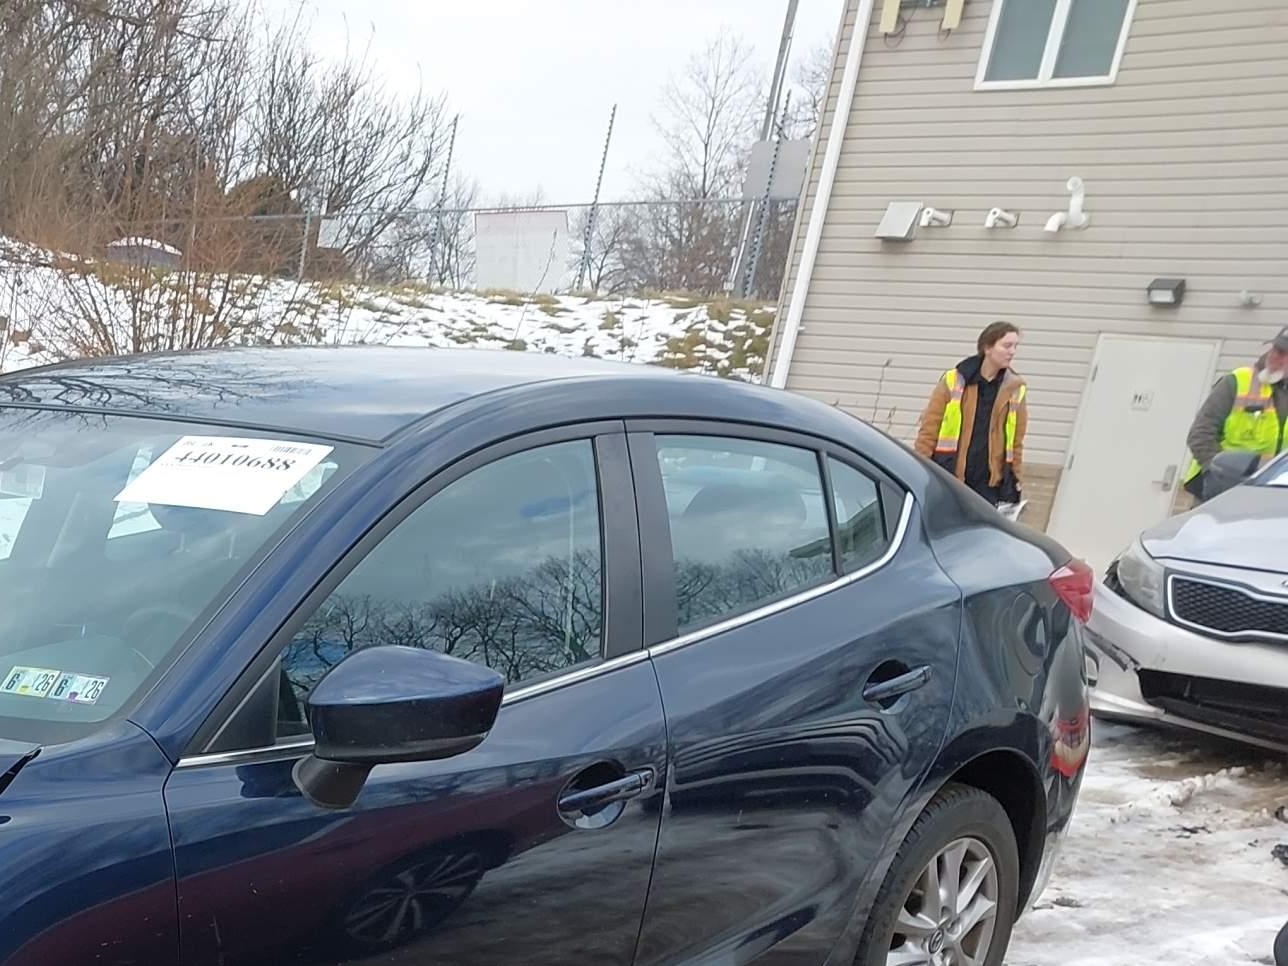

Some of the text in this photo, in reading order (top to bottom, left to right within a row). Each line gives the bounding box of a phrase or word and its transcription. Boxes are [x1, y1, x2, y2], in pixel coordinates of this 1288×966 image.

[175, 451, 297, 471] 44010688
[5, 673, 21, 690] 6
[53, 678, 69, 697] 6
